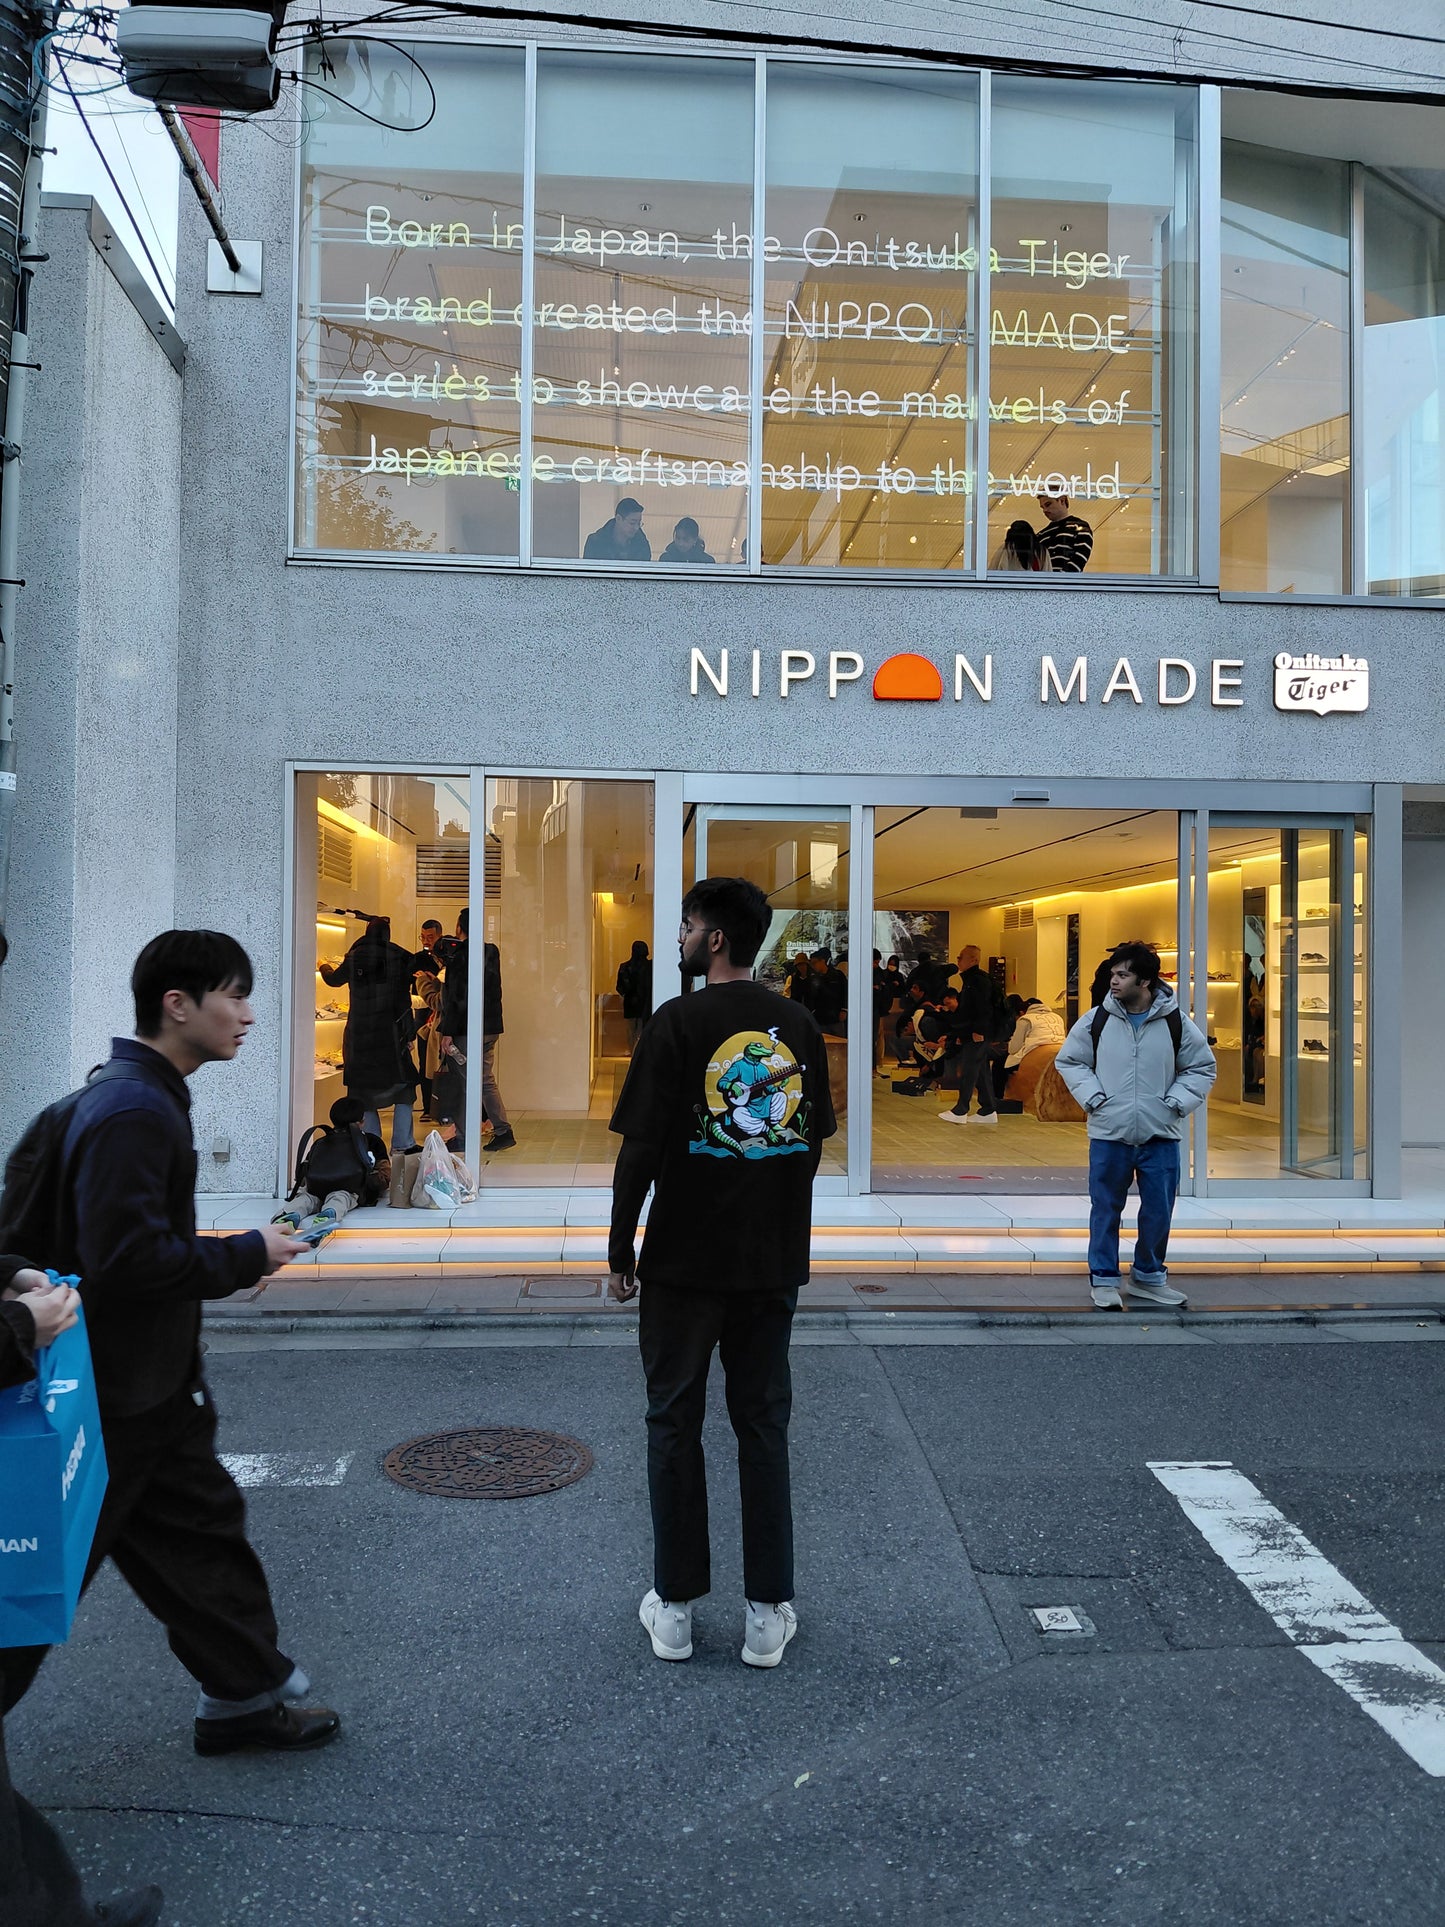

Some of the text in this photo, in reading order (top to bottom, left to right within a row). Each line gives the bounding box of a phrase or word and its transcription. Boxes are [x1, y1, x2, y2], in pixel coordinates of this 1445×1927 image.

[365, 205, 1131, 289] Born in Japan, the Onitsuka Tiger
[365, 283, 493, 327] brand
[513, 295, 678, 333] created
[991, 309, 1129, 354] MADE
[362, 361, 491, 401] series
[510, 370, 554, 404] to
[576, 367, 791, 414] showcae
[811, 377, 881, 416] the
[1087, 389, 1131, 426] of
[571, 448, 861, 503] craftsmanship
[876, 460, 916, 493] to
[931, 457, 995, 496] th
[1040, 655, 1245, 708] MADE
[1274, 652, 1369, 671] Onitsuka
[1288, 676, 1357, 701] Tiger
